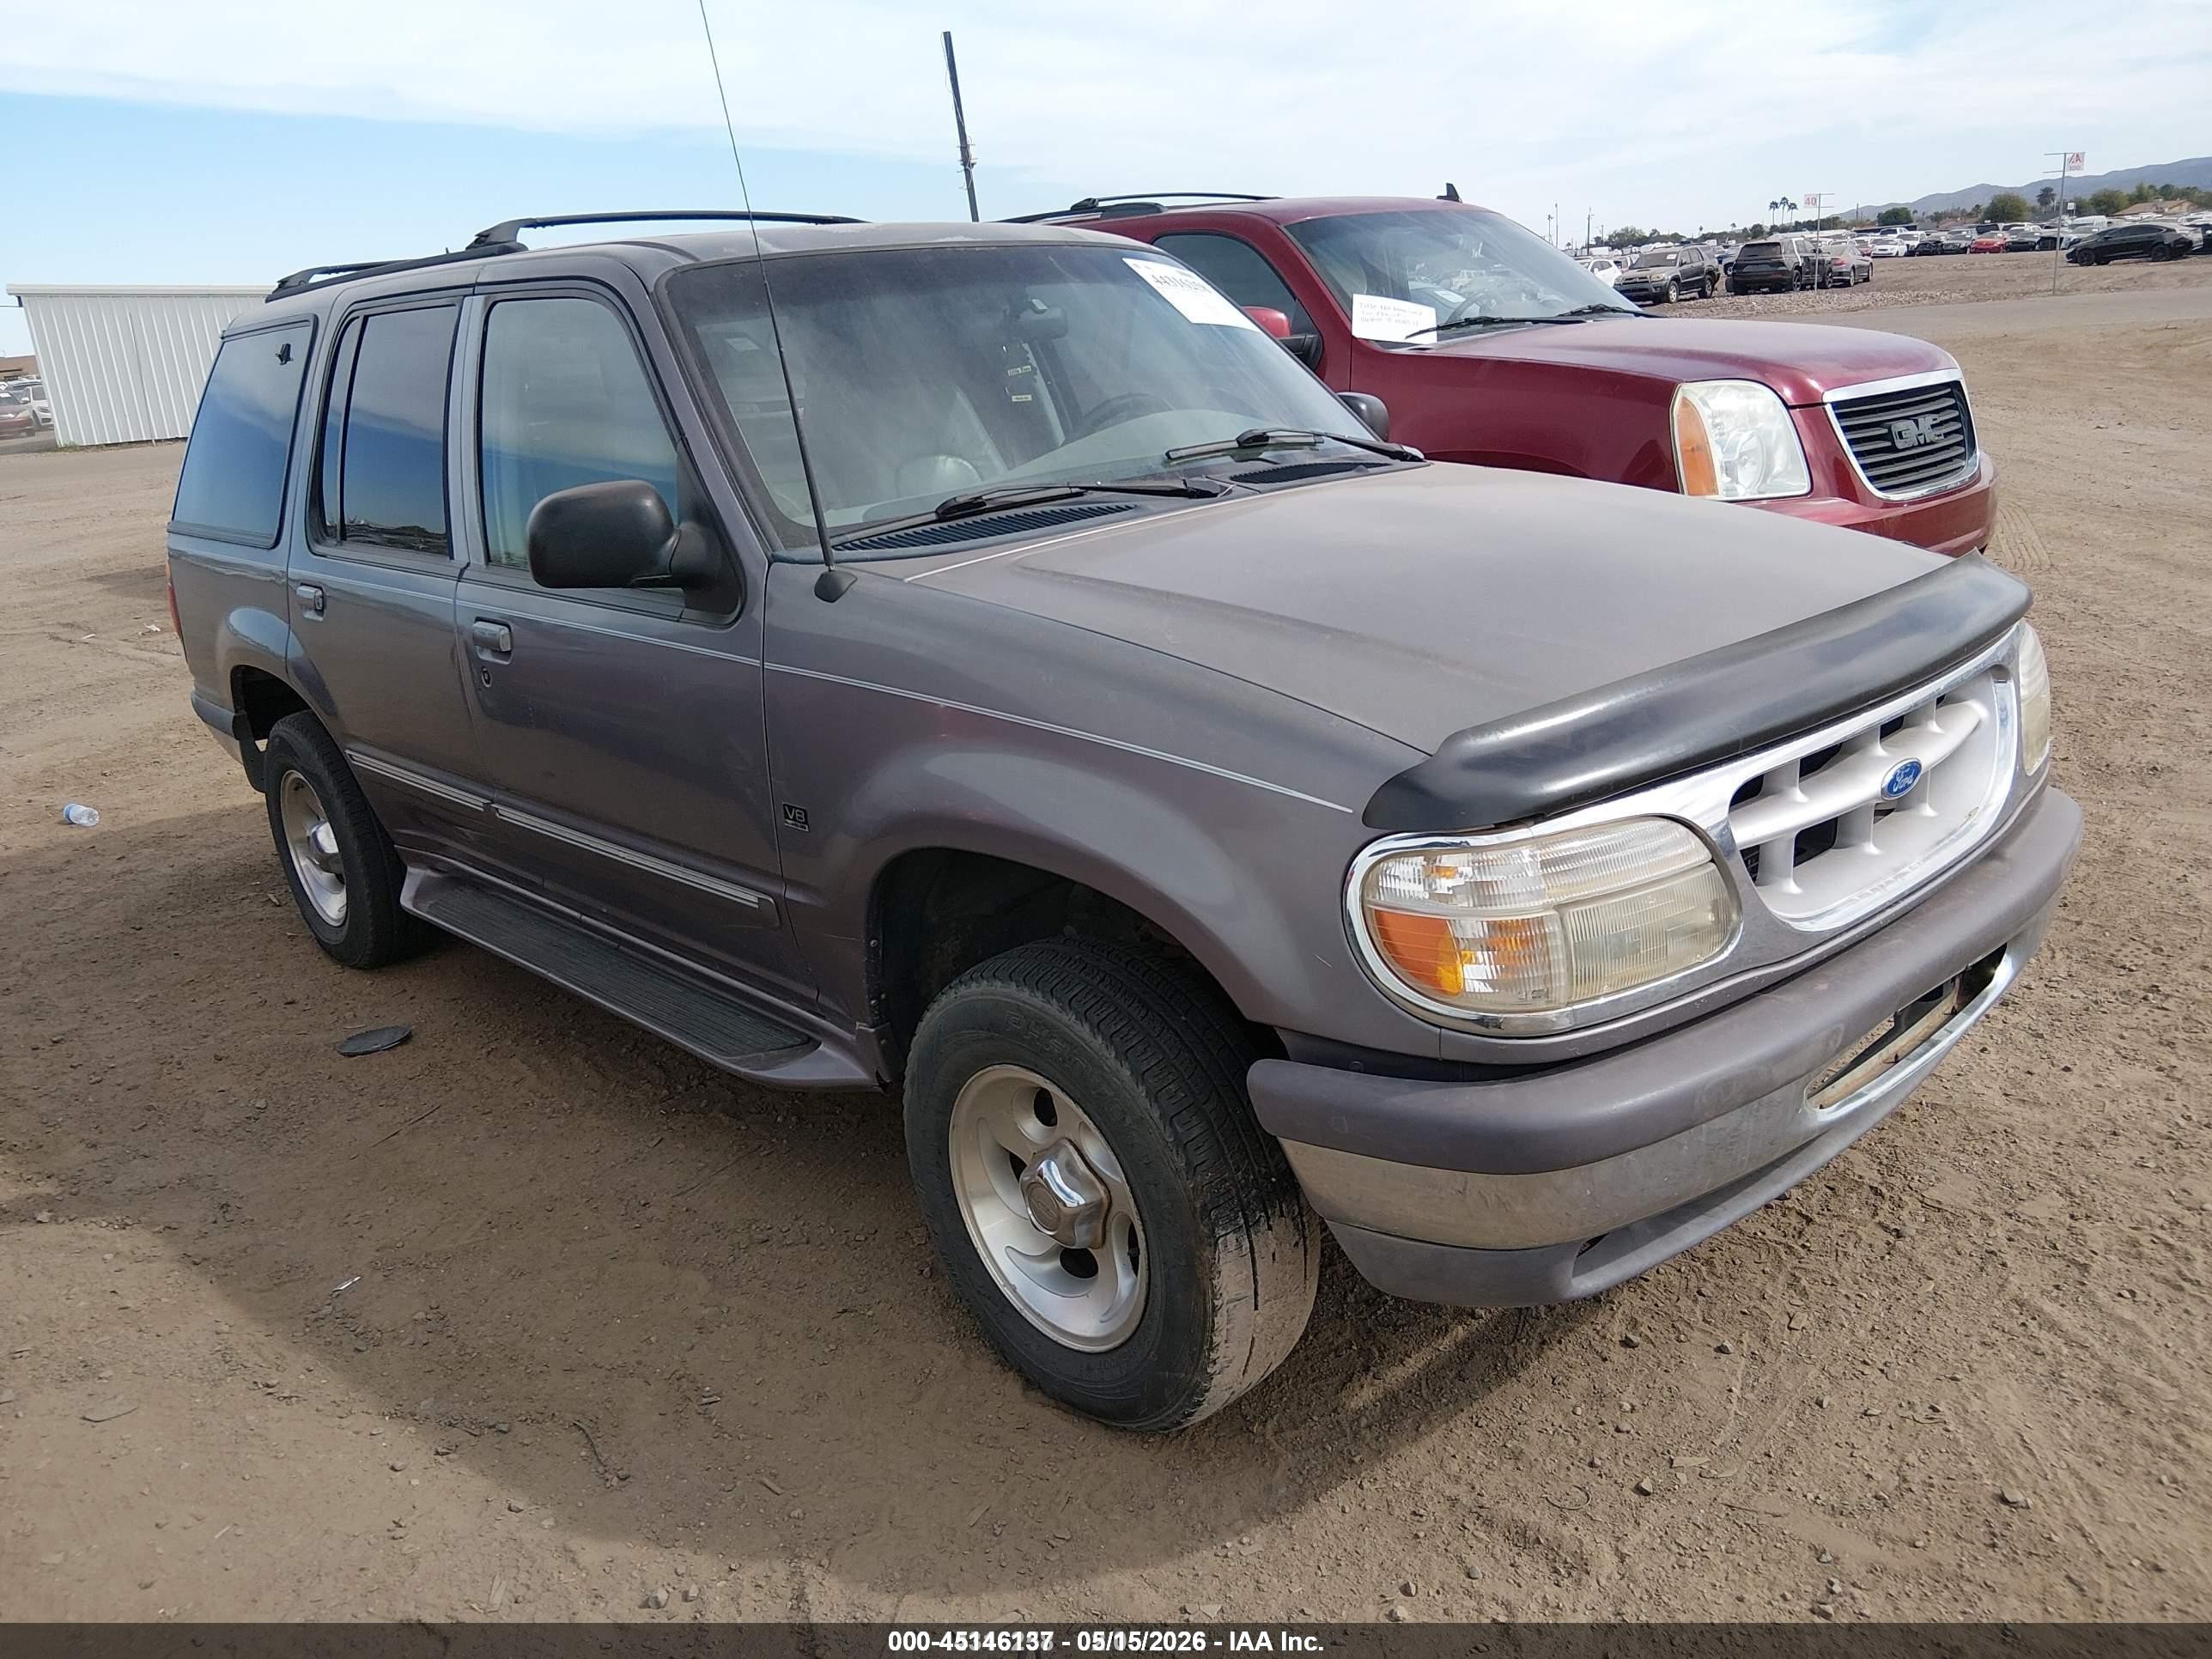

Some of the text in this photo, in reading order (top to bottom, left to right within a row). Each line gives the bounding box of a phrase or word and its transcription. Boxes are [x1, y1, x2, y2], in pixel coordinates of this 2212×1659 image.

[1804, 197, 1817, 206] 40
[1891, 413, 1945, 450] GMC
[1893, 767, 1916, 793] Ford
[785, 805, 805, 823] V8
